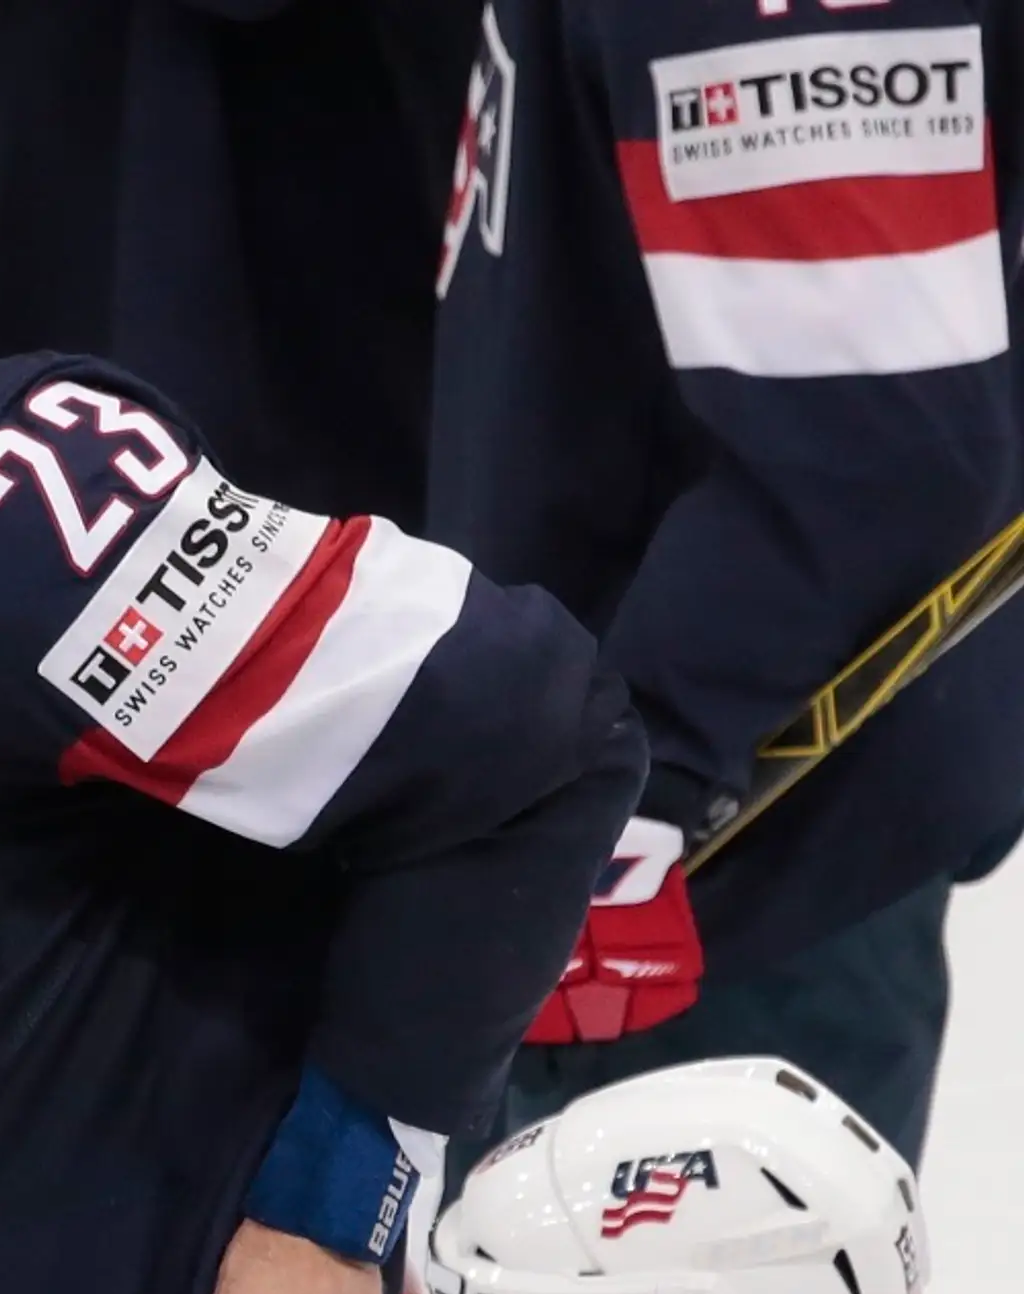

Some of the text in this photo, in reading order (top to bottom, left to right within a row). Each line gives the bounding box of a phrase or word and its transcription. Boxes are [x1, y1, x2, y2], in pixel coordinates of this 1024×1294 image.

[739, 62, 970, 117] TISSOT
[672, 113, 975, 164] SWISS WATCHES SINCE 1853
[114, 653, 178, 727] SWISS
[175, 555, 254, 653] WATCHES
[600, 1149, 720, 1239] USA
